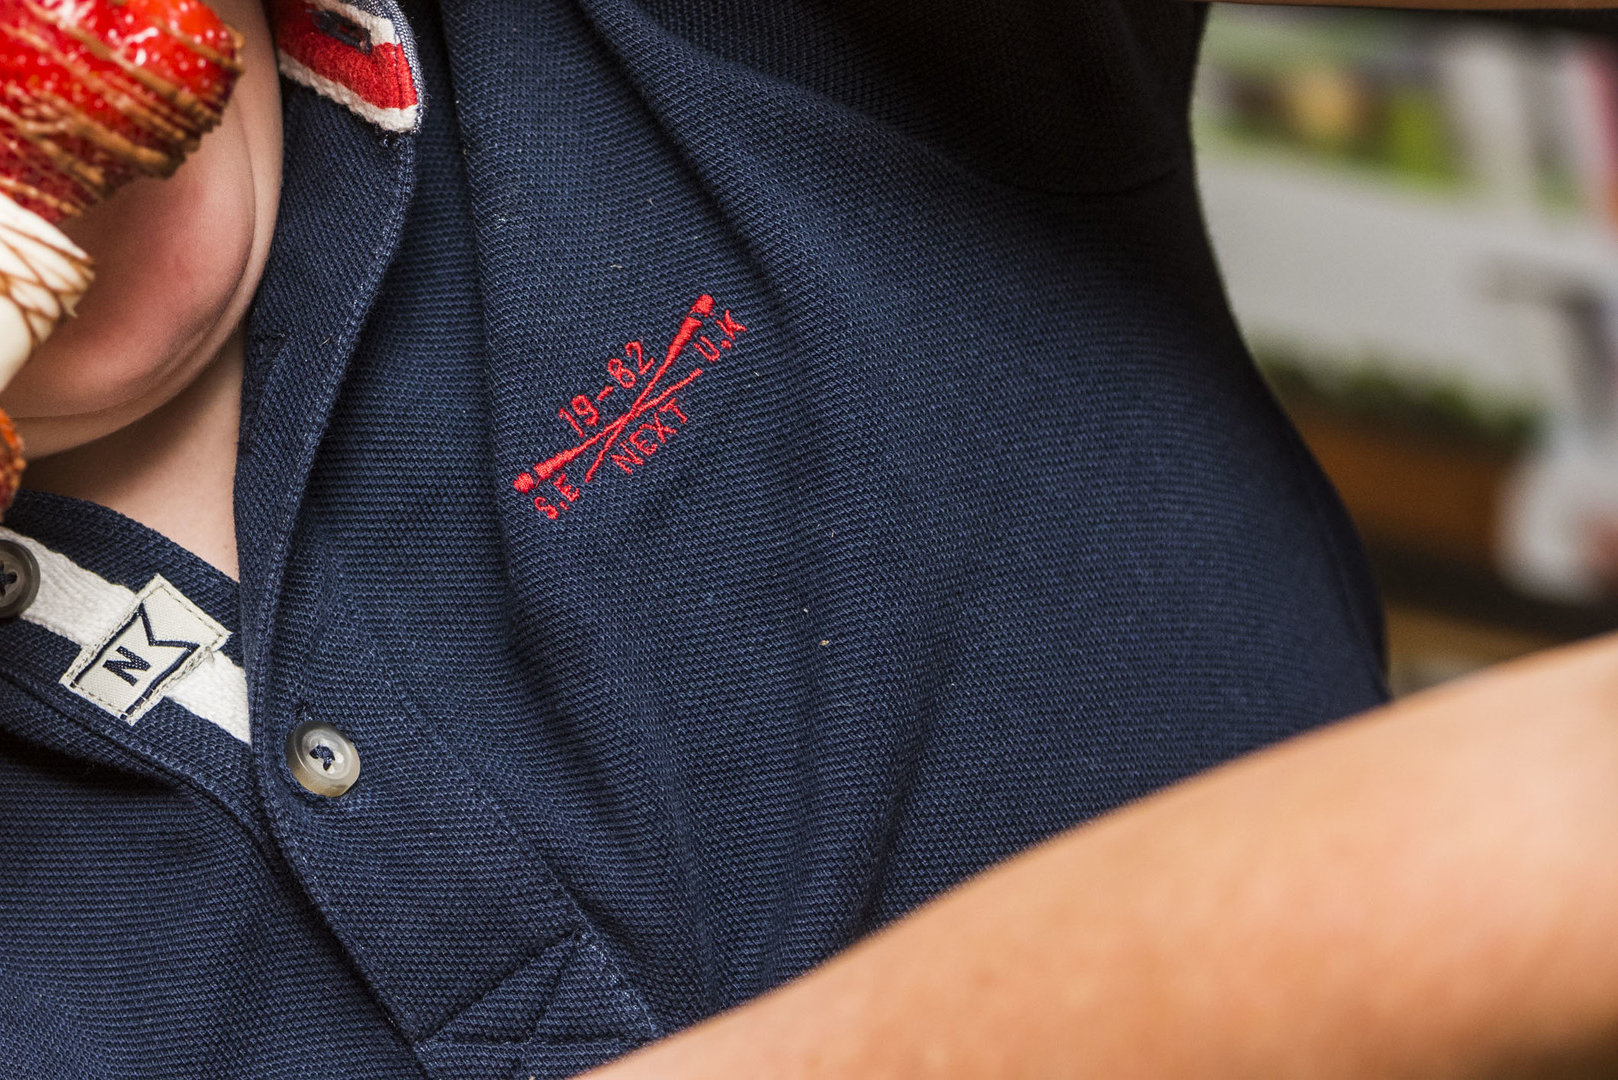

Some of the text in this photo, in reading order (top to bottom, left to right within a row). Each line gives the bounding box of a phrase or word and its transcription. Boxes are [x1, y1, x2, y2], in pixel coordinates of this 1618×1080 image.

[558, 339, 656, 438] 19-82
[610, 396, 688, 475] NEXT
[101, 645, 152, 687] N
